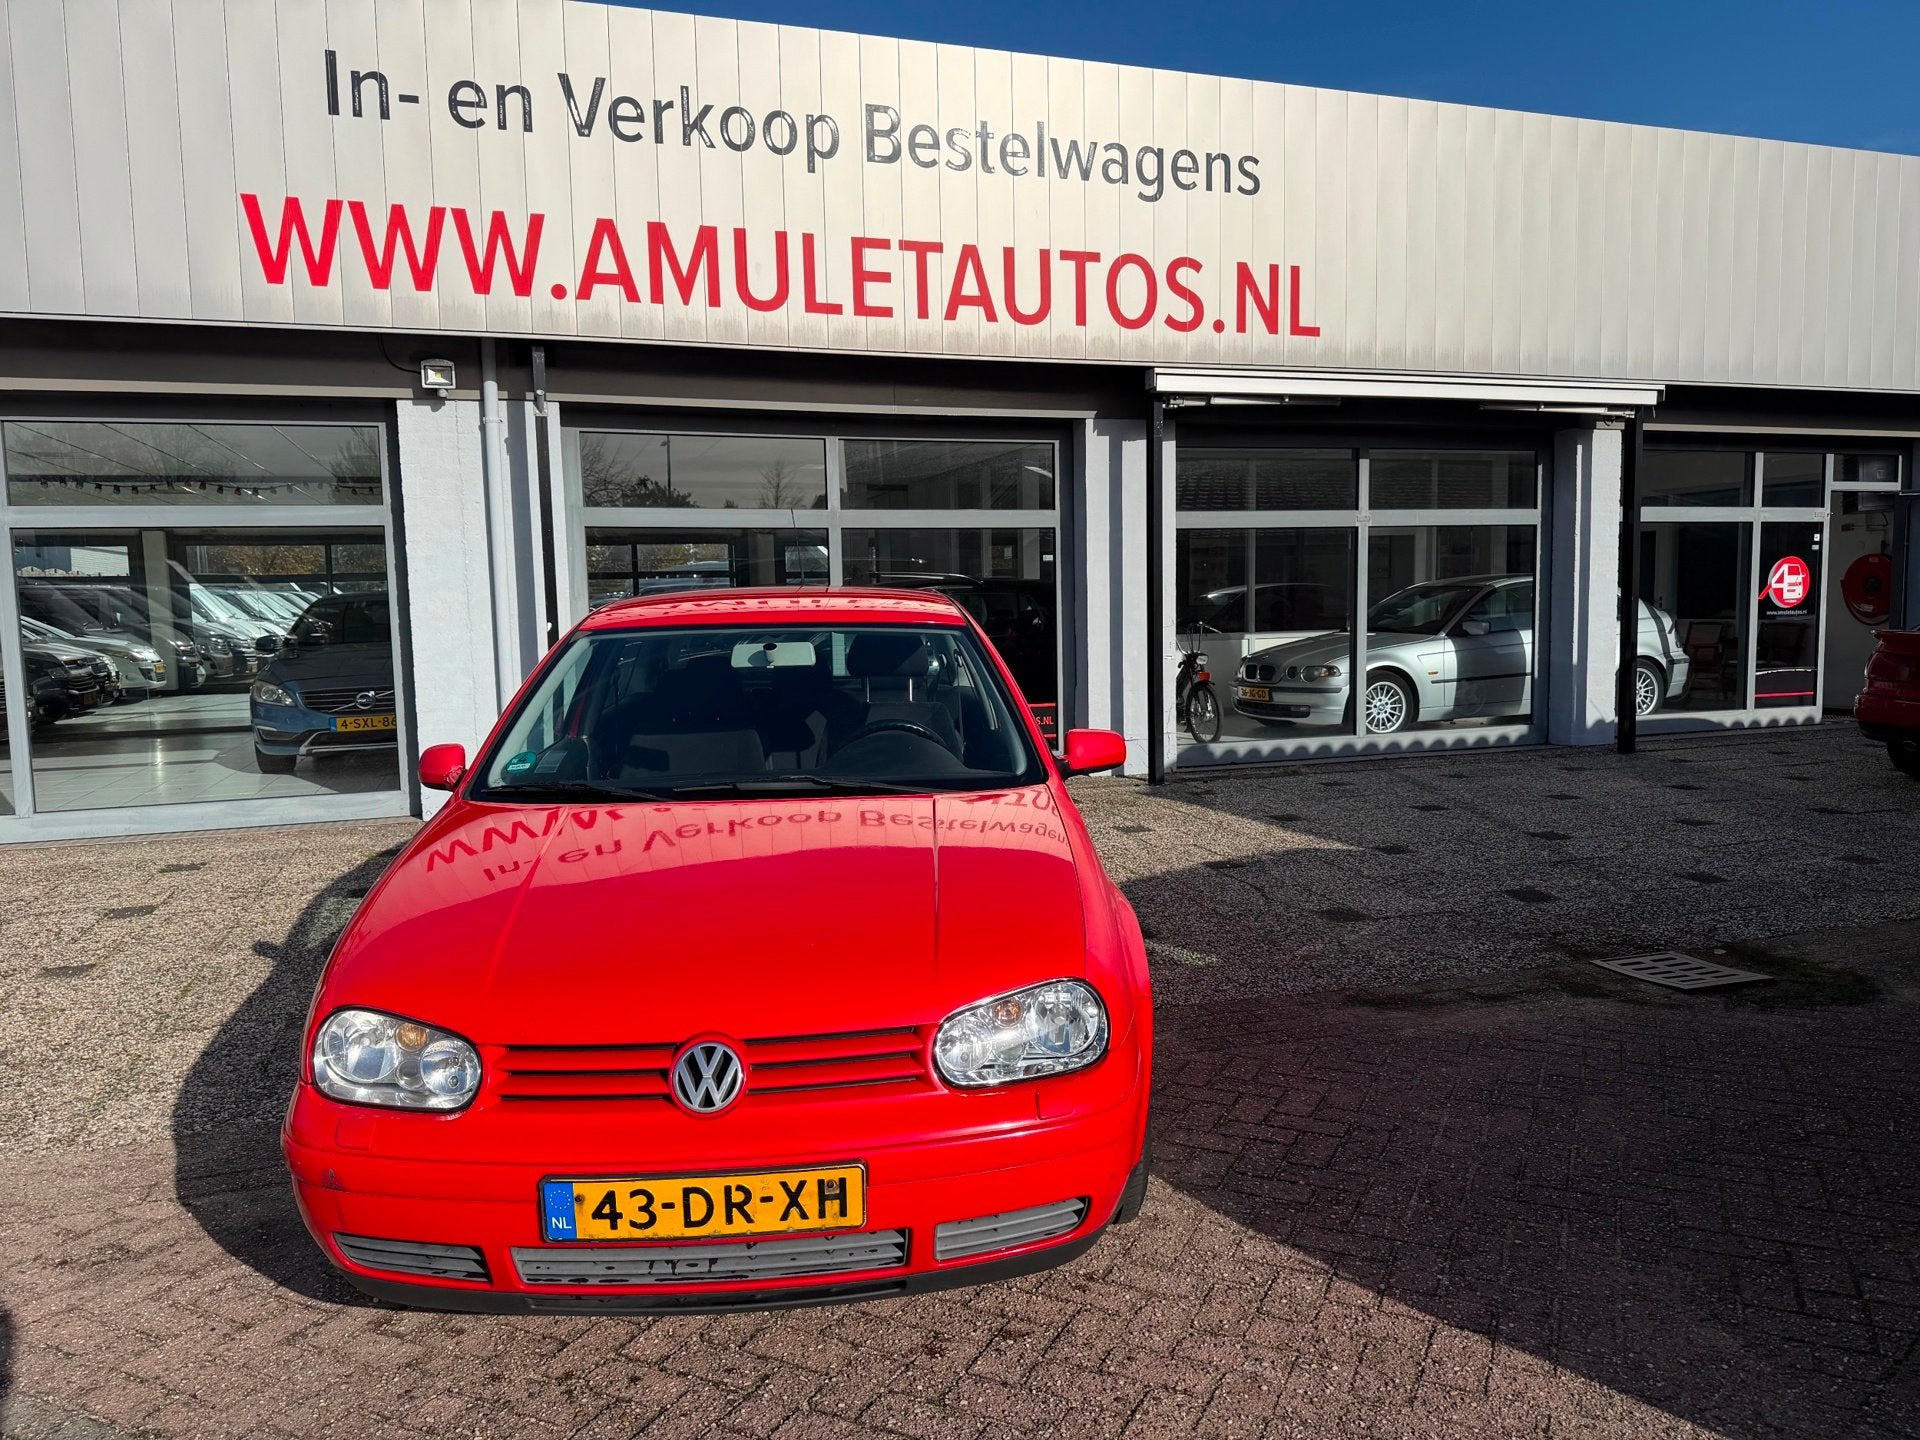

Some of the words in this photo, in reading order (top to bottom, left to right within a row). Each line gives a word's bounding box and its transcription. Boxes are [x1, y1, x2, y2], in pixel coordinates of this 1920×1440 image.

[324, 49, 420, 120] In-
[447, 79, 533, 133] en
[557, 72, 840, 173] Verkoop
[864, 103, 1261, 203] Bestelwagens
[239, 192, 1321, 337] WWW.AMULETAUTOS.NL
[552, 1217, 572, 1230] NL
[591, 1177, 848, 1230] 43-DR-XH
